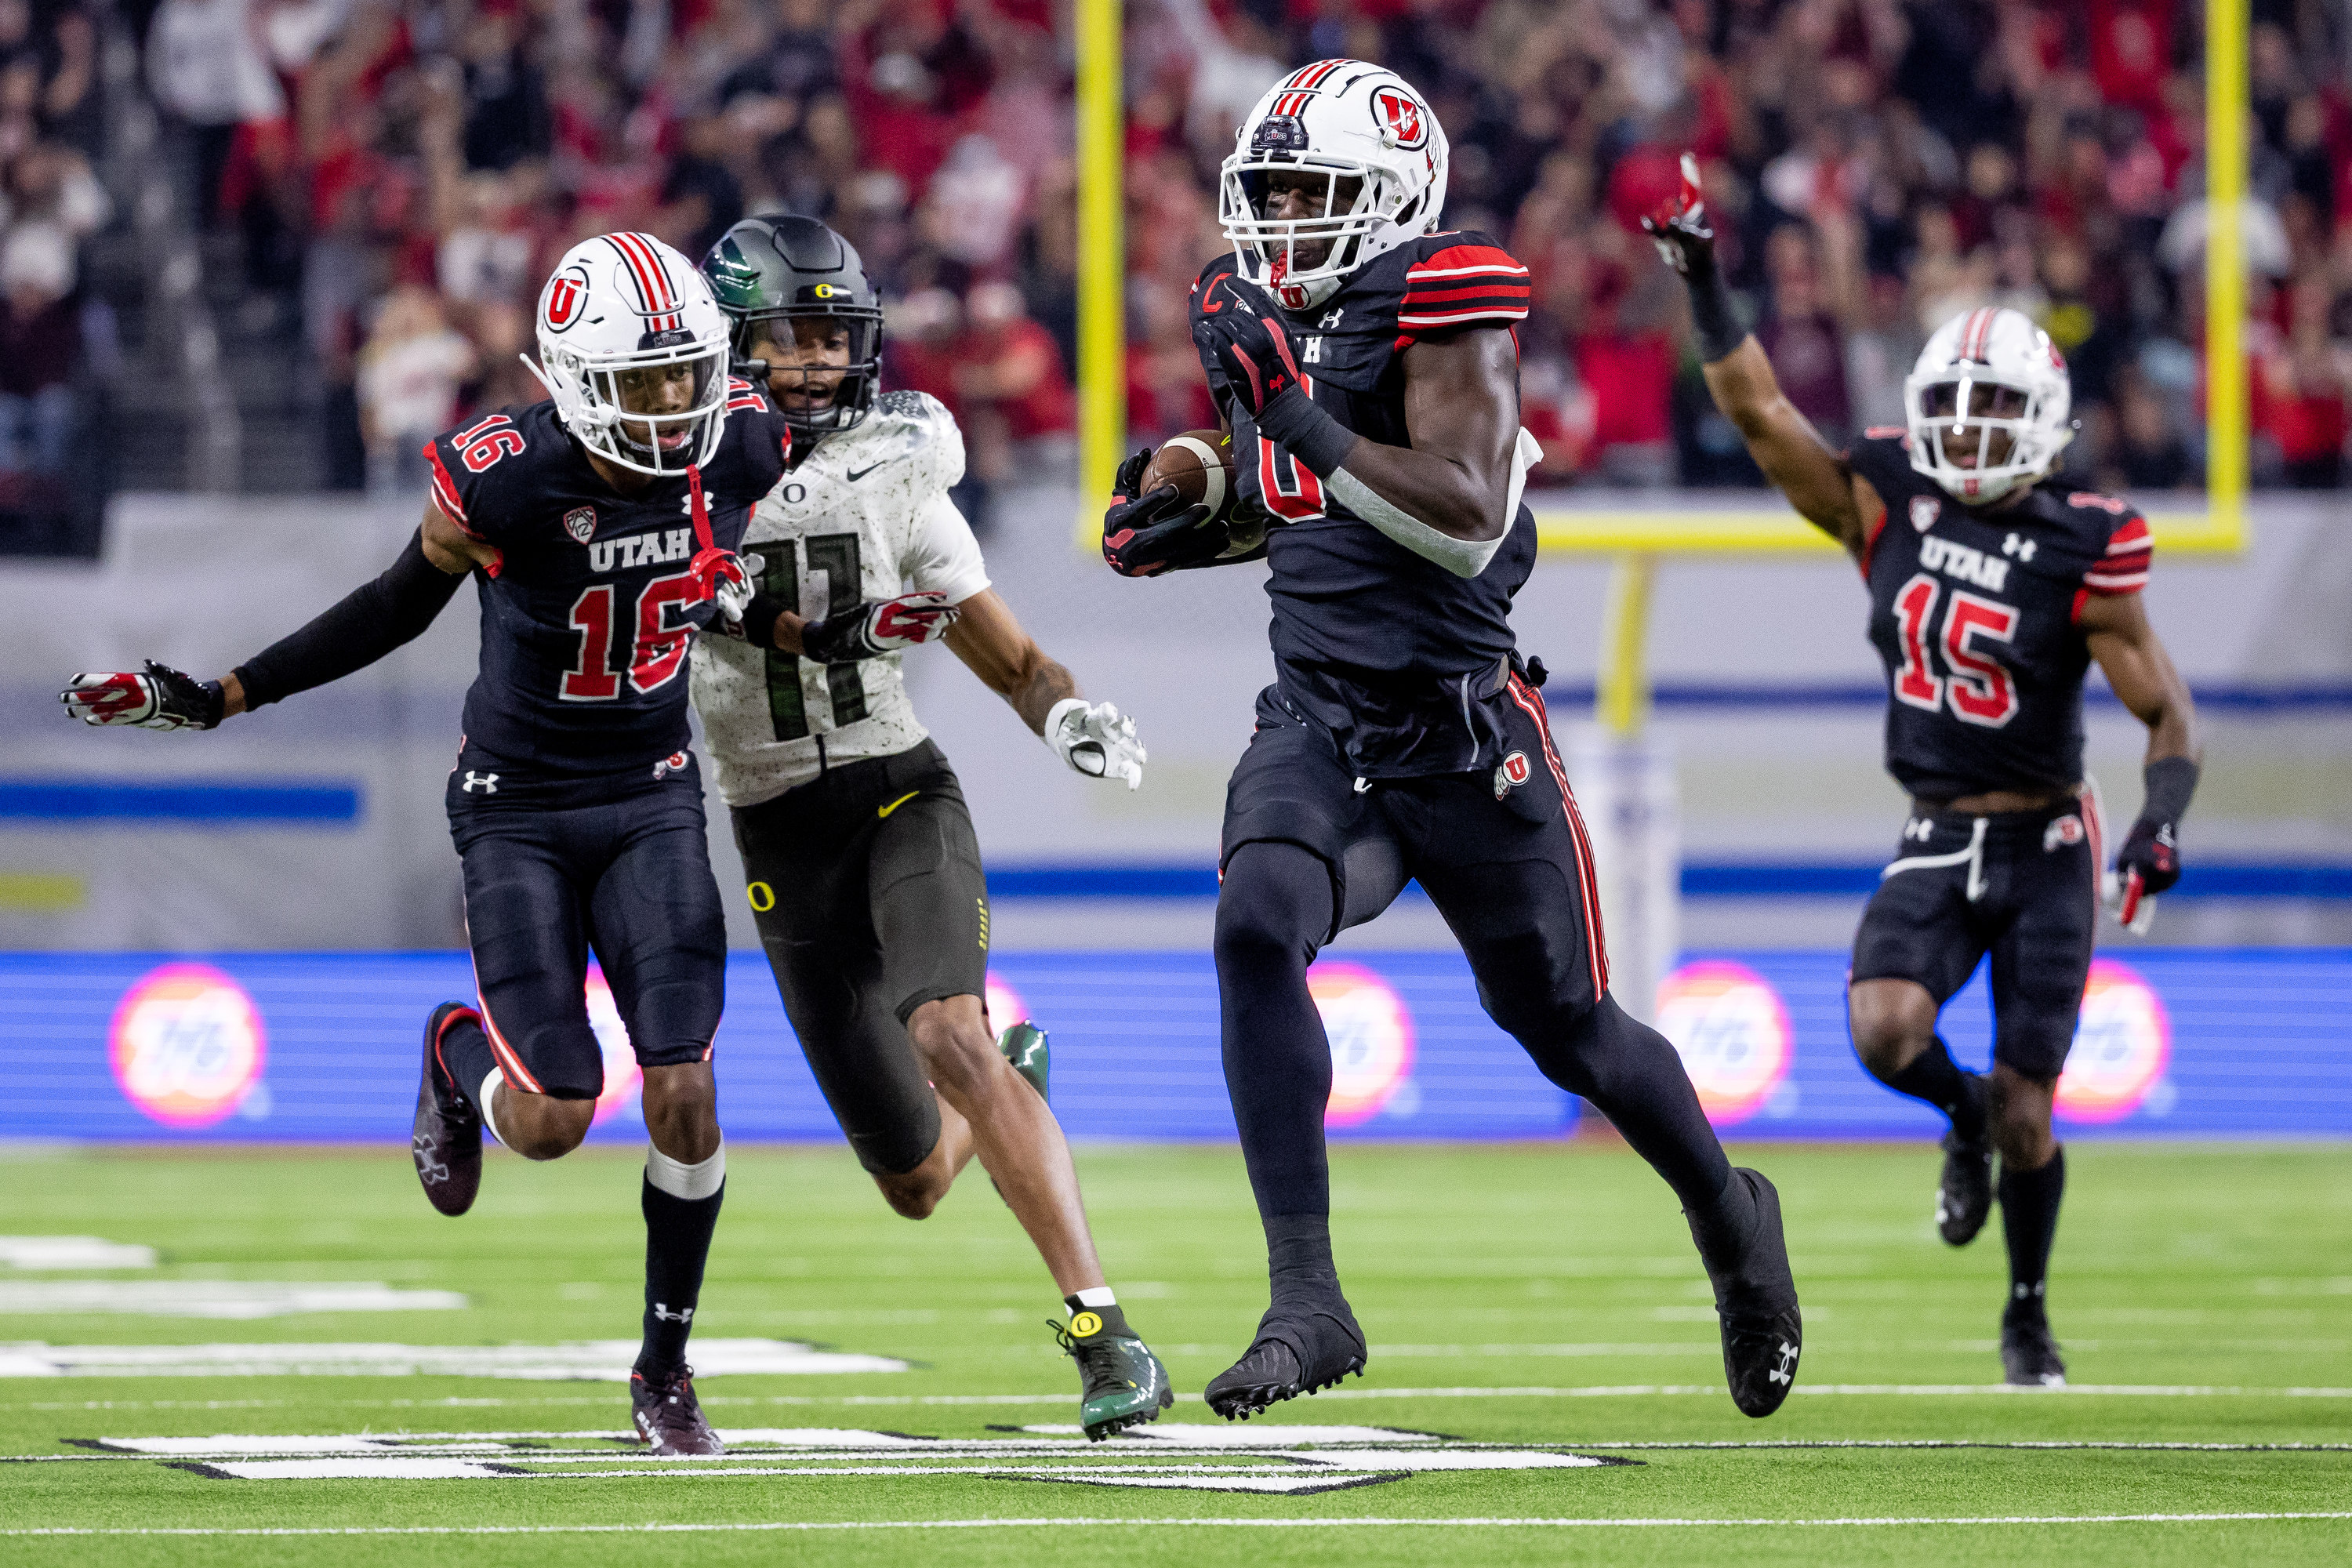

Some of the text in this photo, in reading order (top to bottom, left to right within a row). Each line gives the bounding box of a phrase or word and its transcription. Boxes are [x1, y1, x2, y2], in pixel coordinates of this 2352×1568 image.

[549, 278, 583, 325] U
[1280, 286, 1305, 309] U
[451, 414, 527, 474] 16
[588, 527, 692, 573] UTAH
[1918, 533, 2011, 593] UTAH
[557, 570, 705, 702] 16
[1891, 571, 2021, 730] 15
[1504, 755, 1527, 782] U
